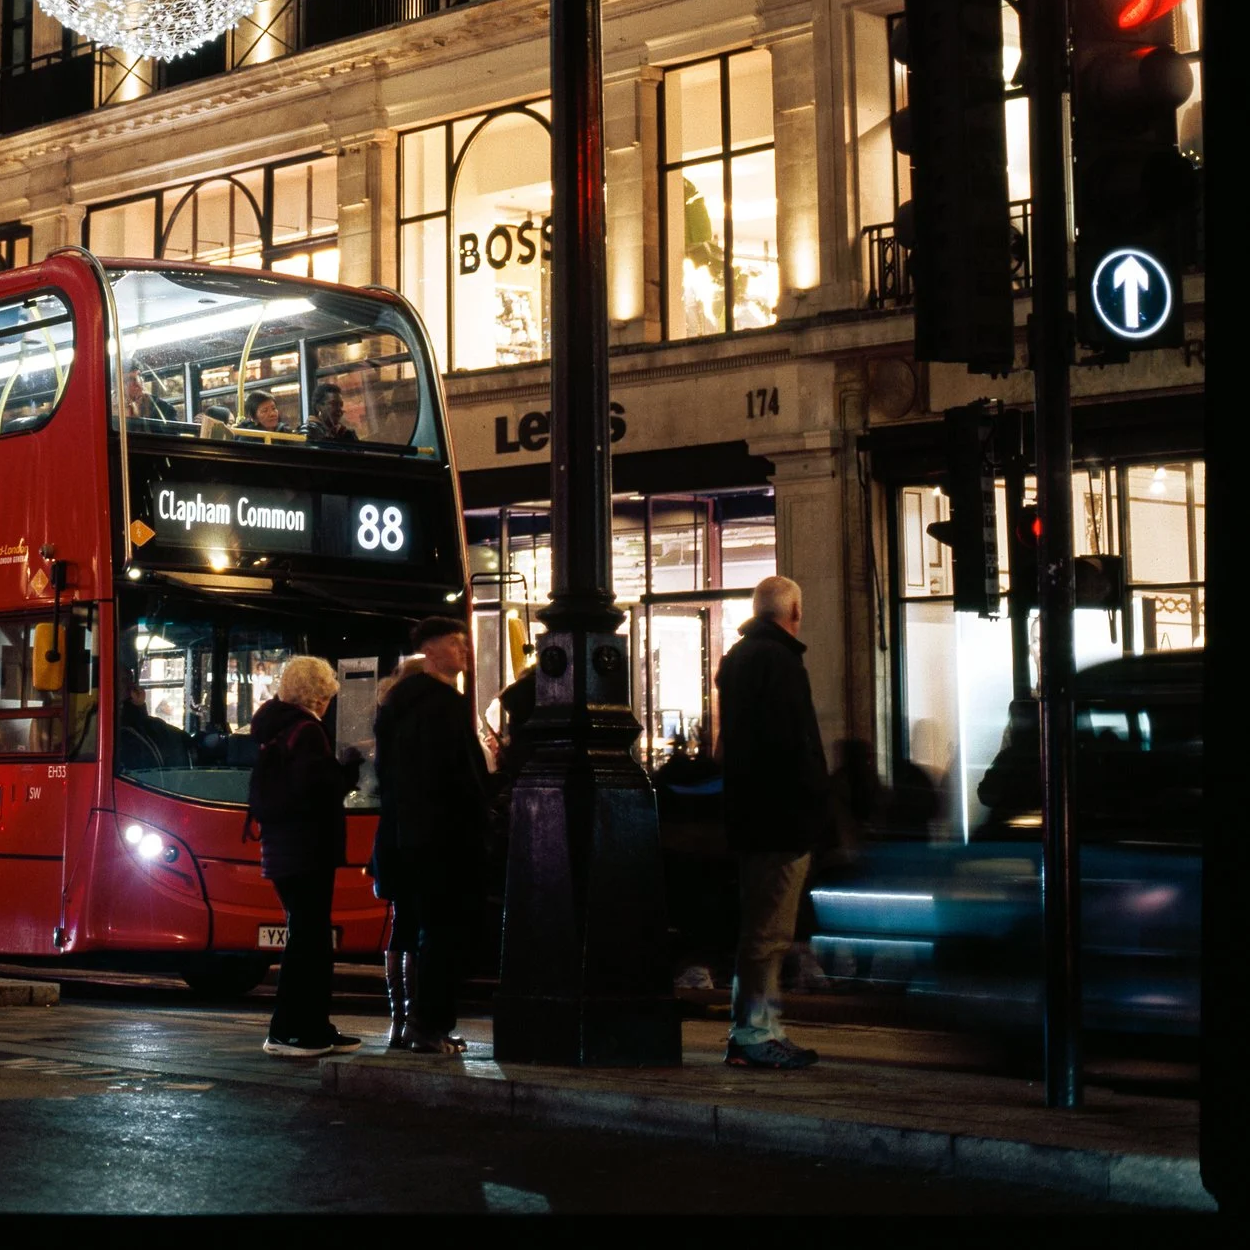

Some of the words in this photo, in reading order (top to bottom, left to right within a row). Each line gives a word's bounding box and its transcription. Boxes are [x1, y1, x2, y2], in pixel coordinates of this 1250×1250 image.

[459, 216, 553, 275] BOSS
[746, 387, 780, 420] 174
[495, 402, 627, 454] Les
[159, 490, 230, 530] Clapham
[237, 497, 305, 531] Common
[357, 504, 404, 551] 88
[48, 765, 67, 778] EH33
[30, 787, 41, 800] SW
[268, 929, 289, 945] YX
